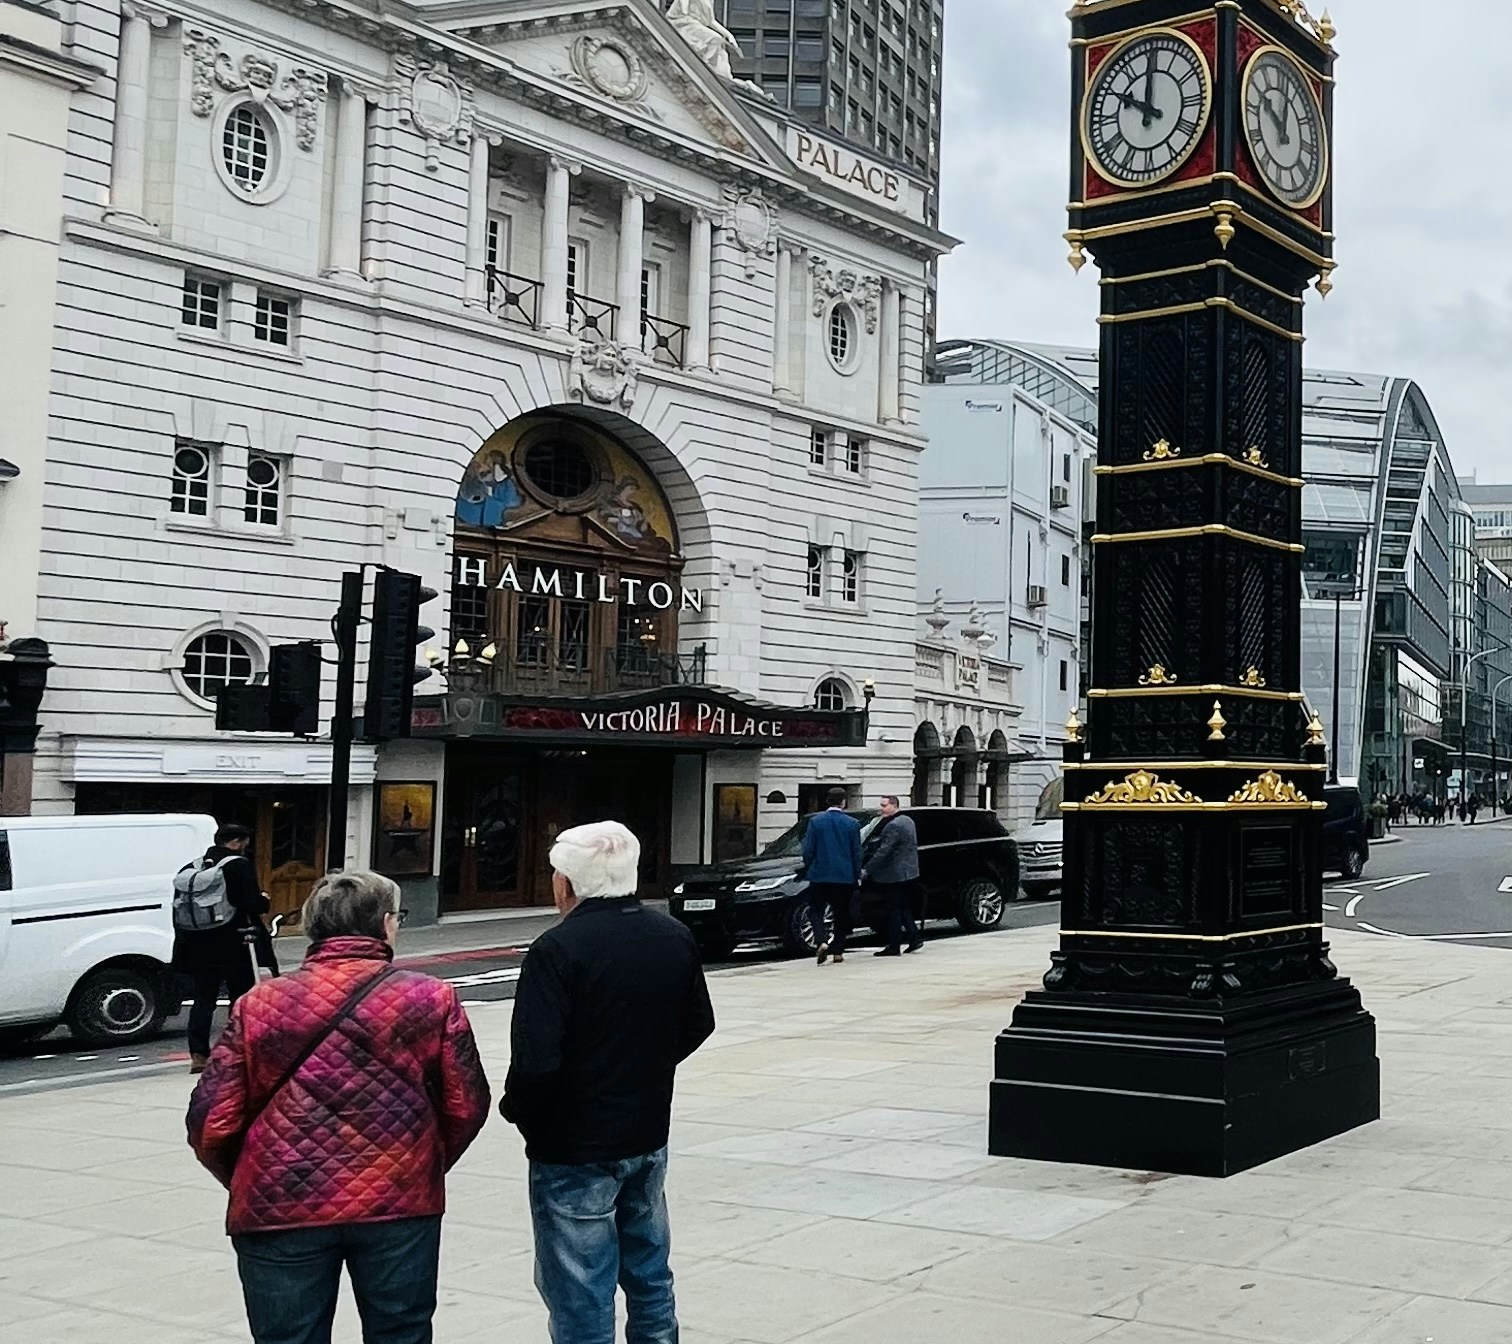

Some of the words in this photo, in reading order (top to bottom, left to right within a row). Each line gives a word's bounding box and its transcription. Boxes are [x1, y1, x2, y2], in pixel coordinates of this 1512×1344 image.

[797, 132, 899, 202] PALACE
[457, 556, 704, 613] HAMILTON
[581, 701, 680, 732] VICTORIA
[697, 703, 784, 736] PALACE
[216, 755, 260, 768] EXIT
